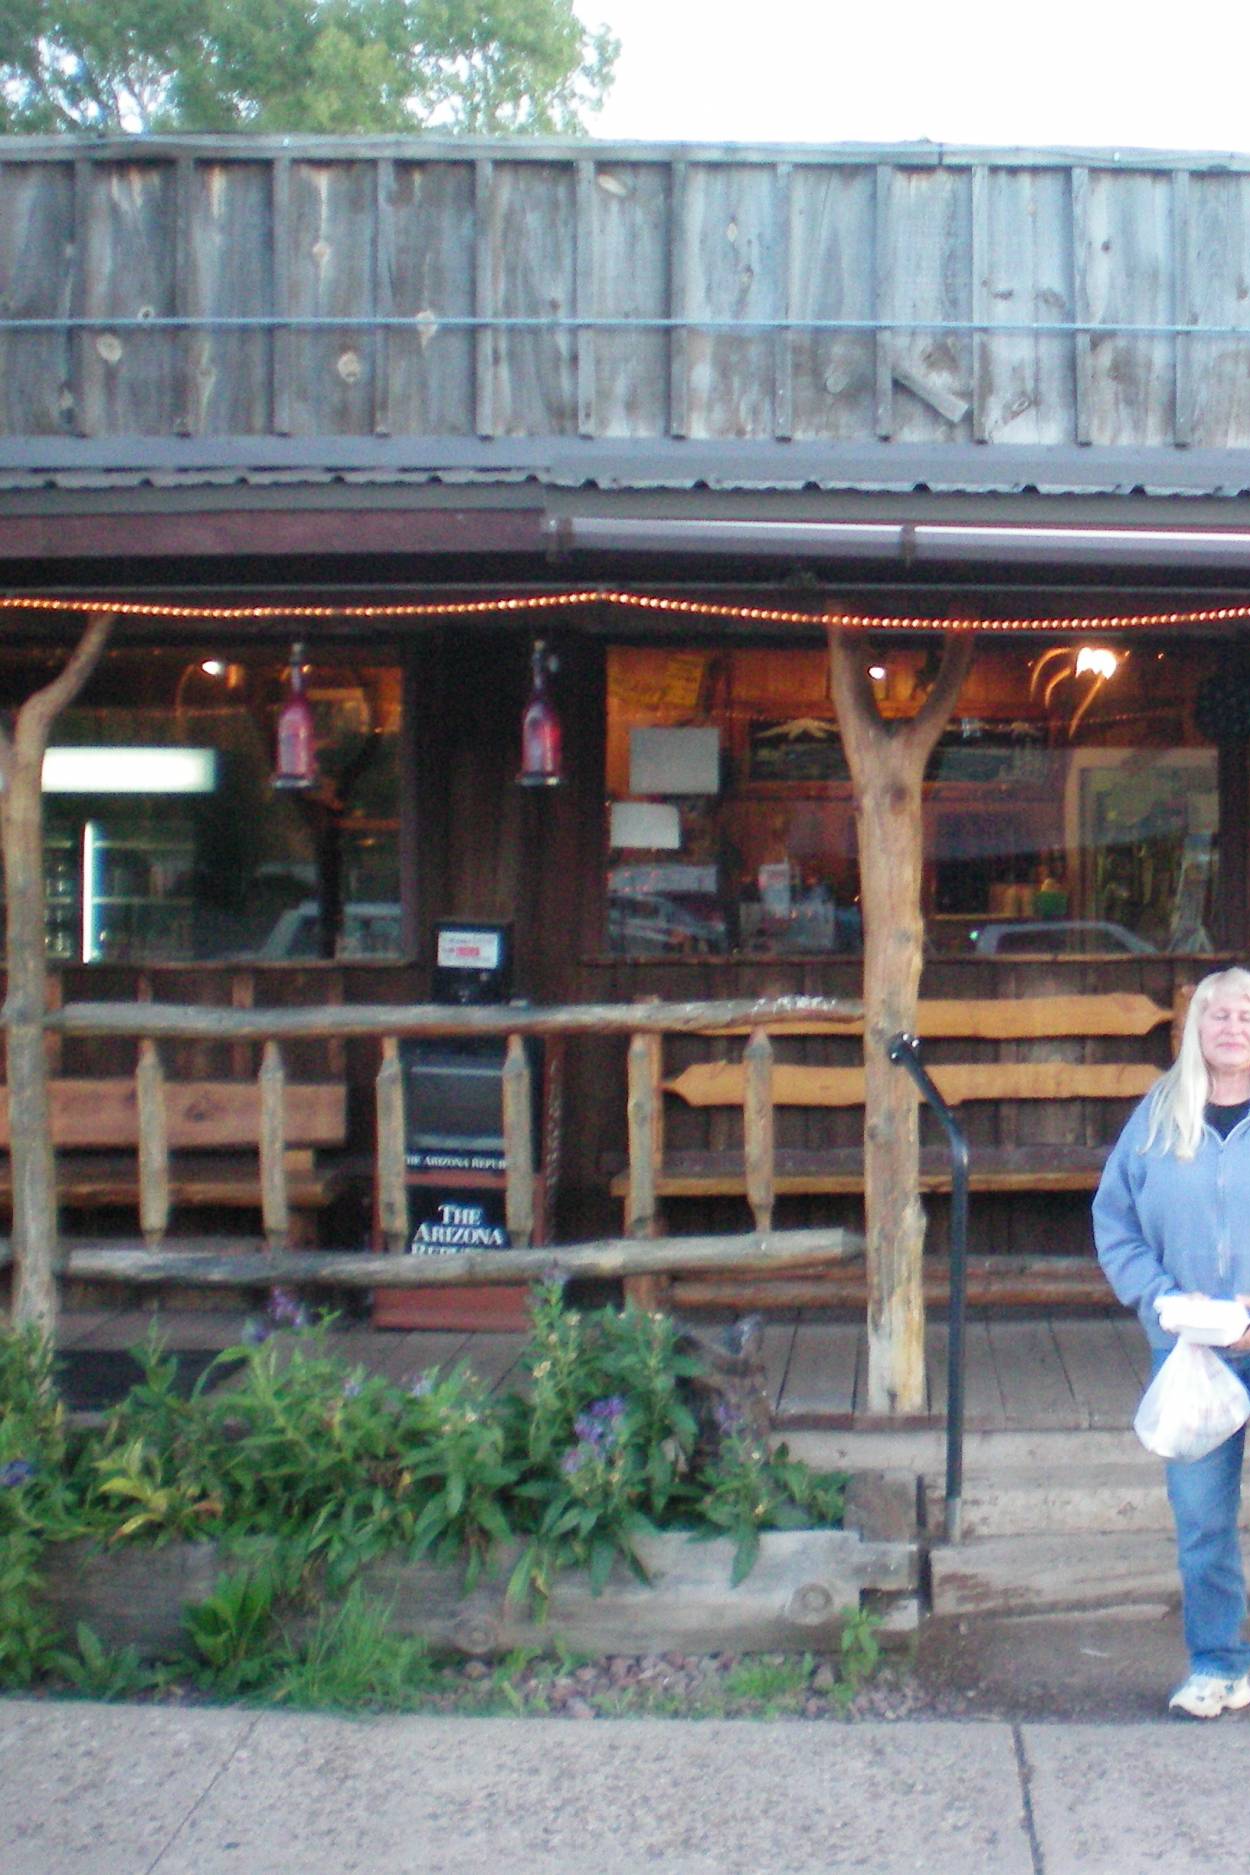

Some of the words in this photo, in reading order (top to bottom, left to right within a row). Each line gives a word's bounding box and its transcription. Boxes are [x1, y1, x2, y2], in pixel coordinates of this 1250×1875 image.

[424, 1155, 470, 1168] ARIZONA
[438, 1204, 482, 1226] THE
[413, 1222, 505, 1246] ARIZONA
